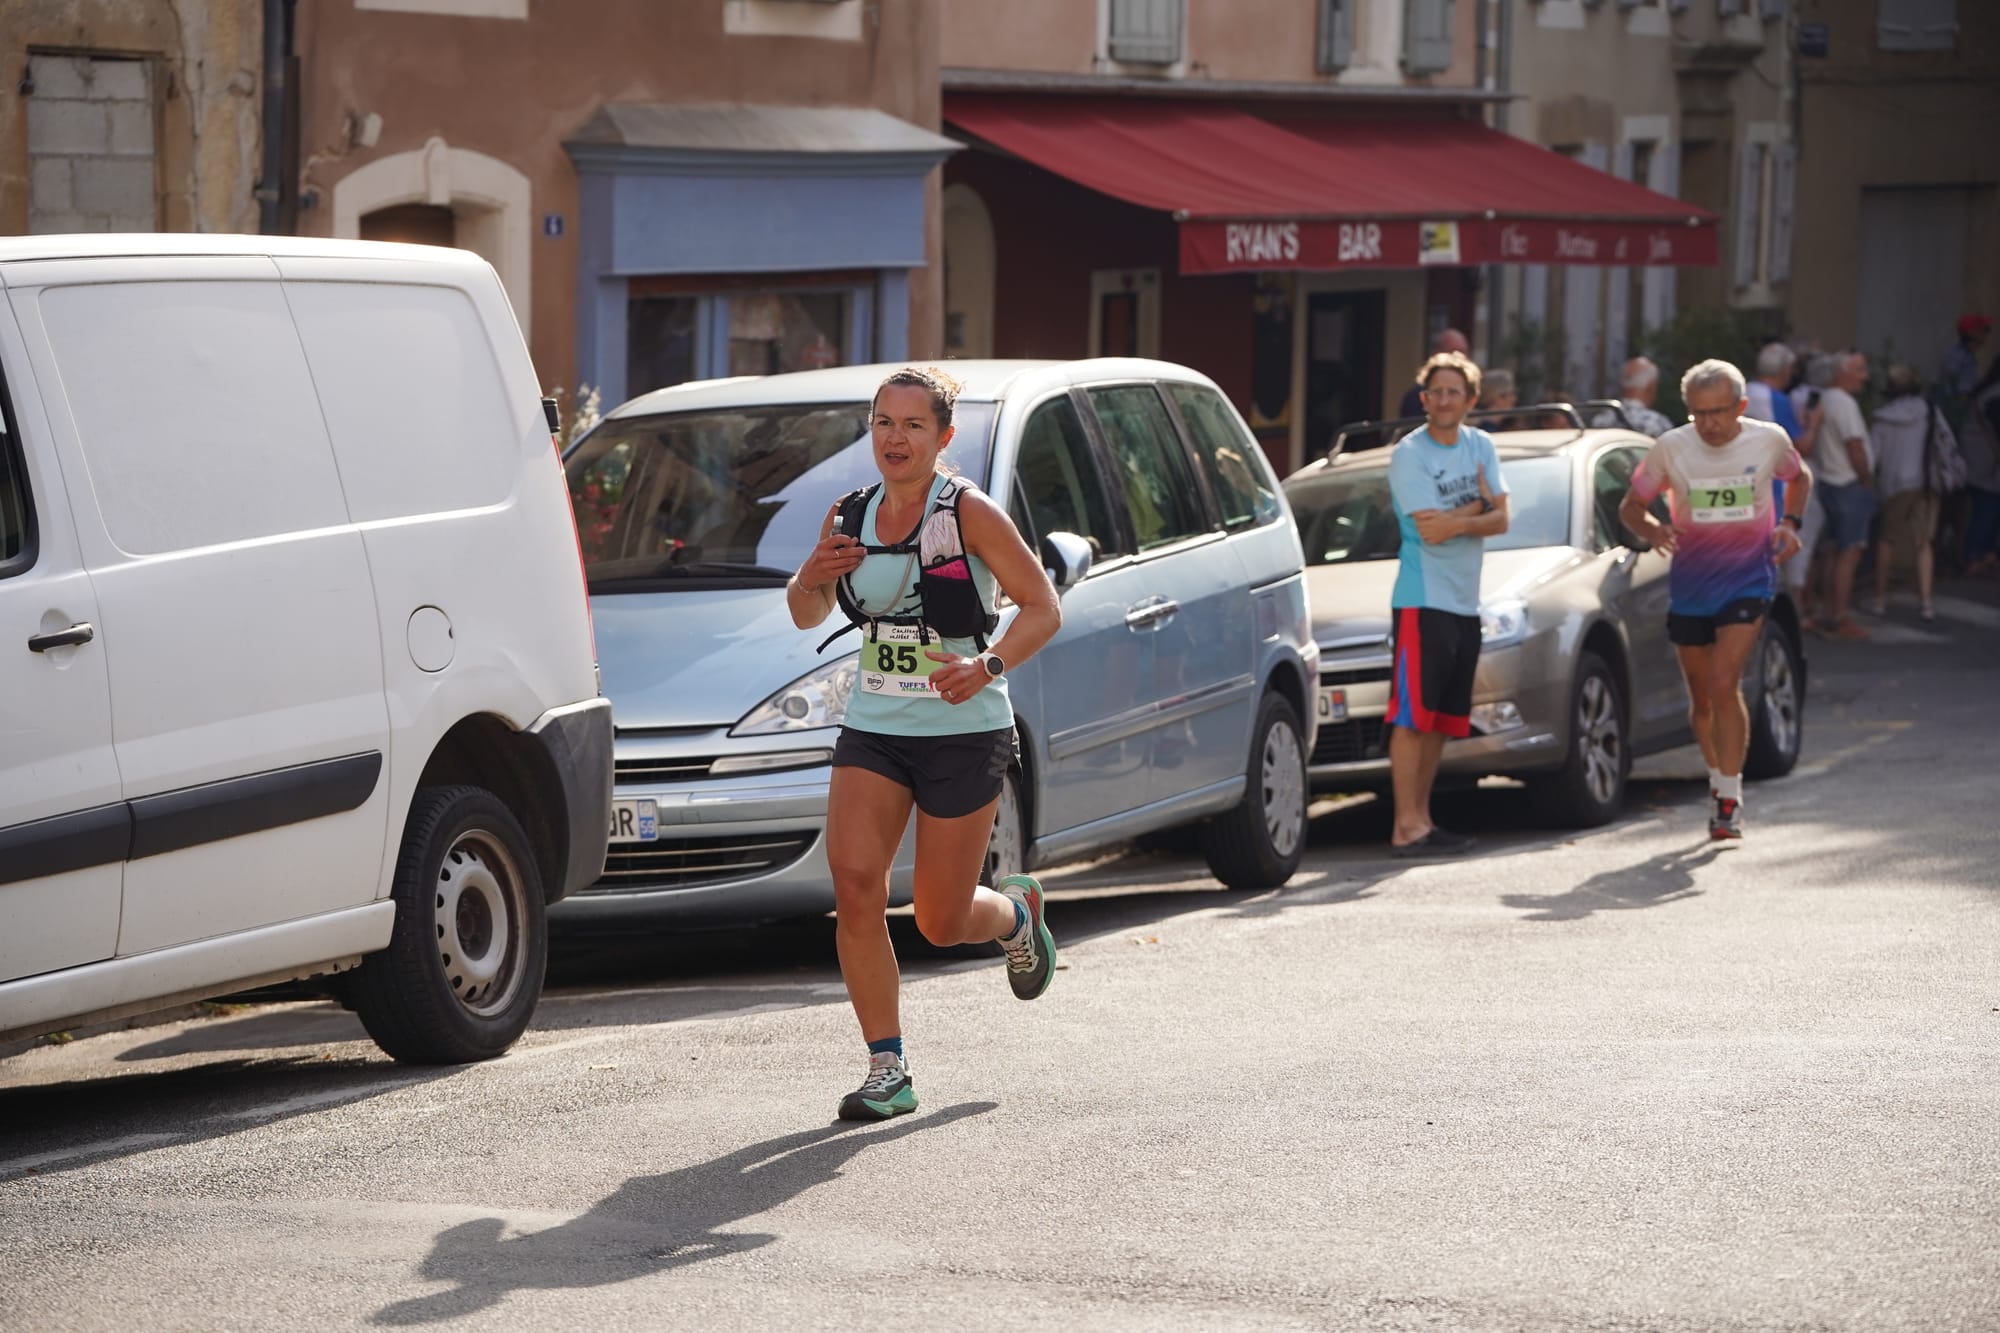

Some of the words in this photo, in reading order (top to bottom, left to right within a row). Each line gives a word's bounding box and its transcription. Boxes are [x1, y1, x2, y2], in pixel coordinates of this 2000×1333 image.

[1226, 223, 1300, 263] RYAN'S
[1338, 224, 1382, 261] BAR
[1706, 489, 1736, 507] 79
[878, 644, 918, 673] 85
